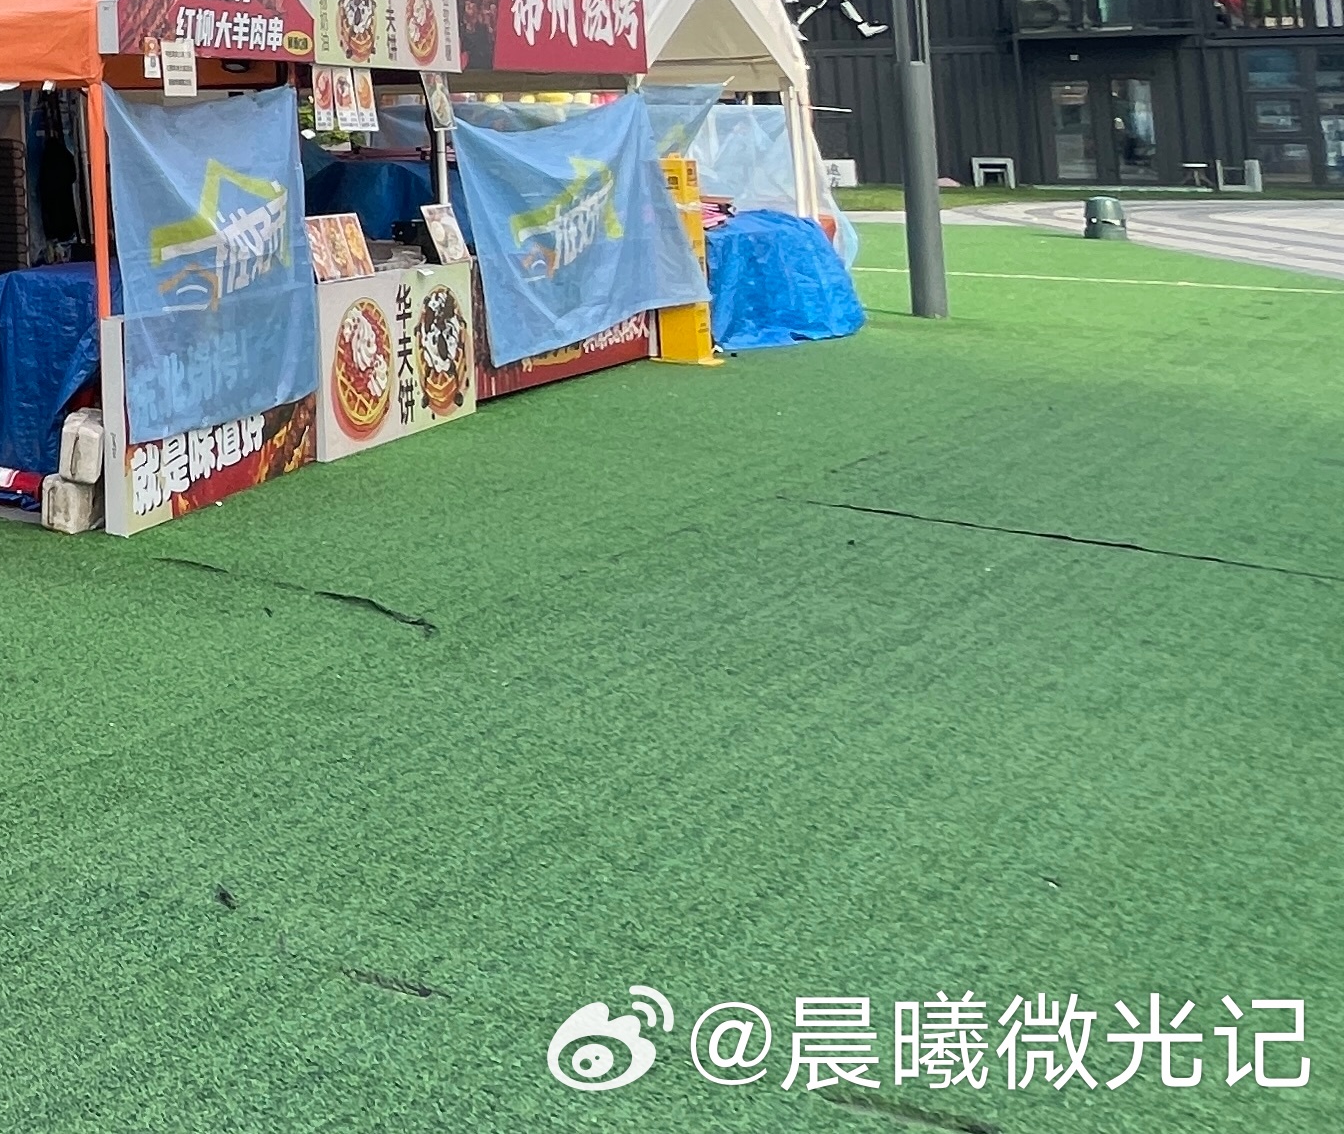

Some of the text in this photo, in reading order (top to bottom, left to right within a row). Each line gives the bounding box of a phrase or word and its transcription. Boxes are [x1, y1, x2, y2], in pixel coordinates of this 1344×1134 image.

[176, 7, 284, 51] 红柳大羊肉串
[396, 283, 415, 425] 华夫饼
